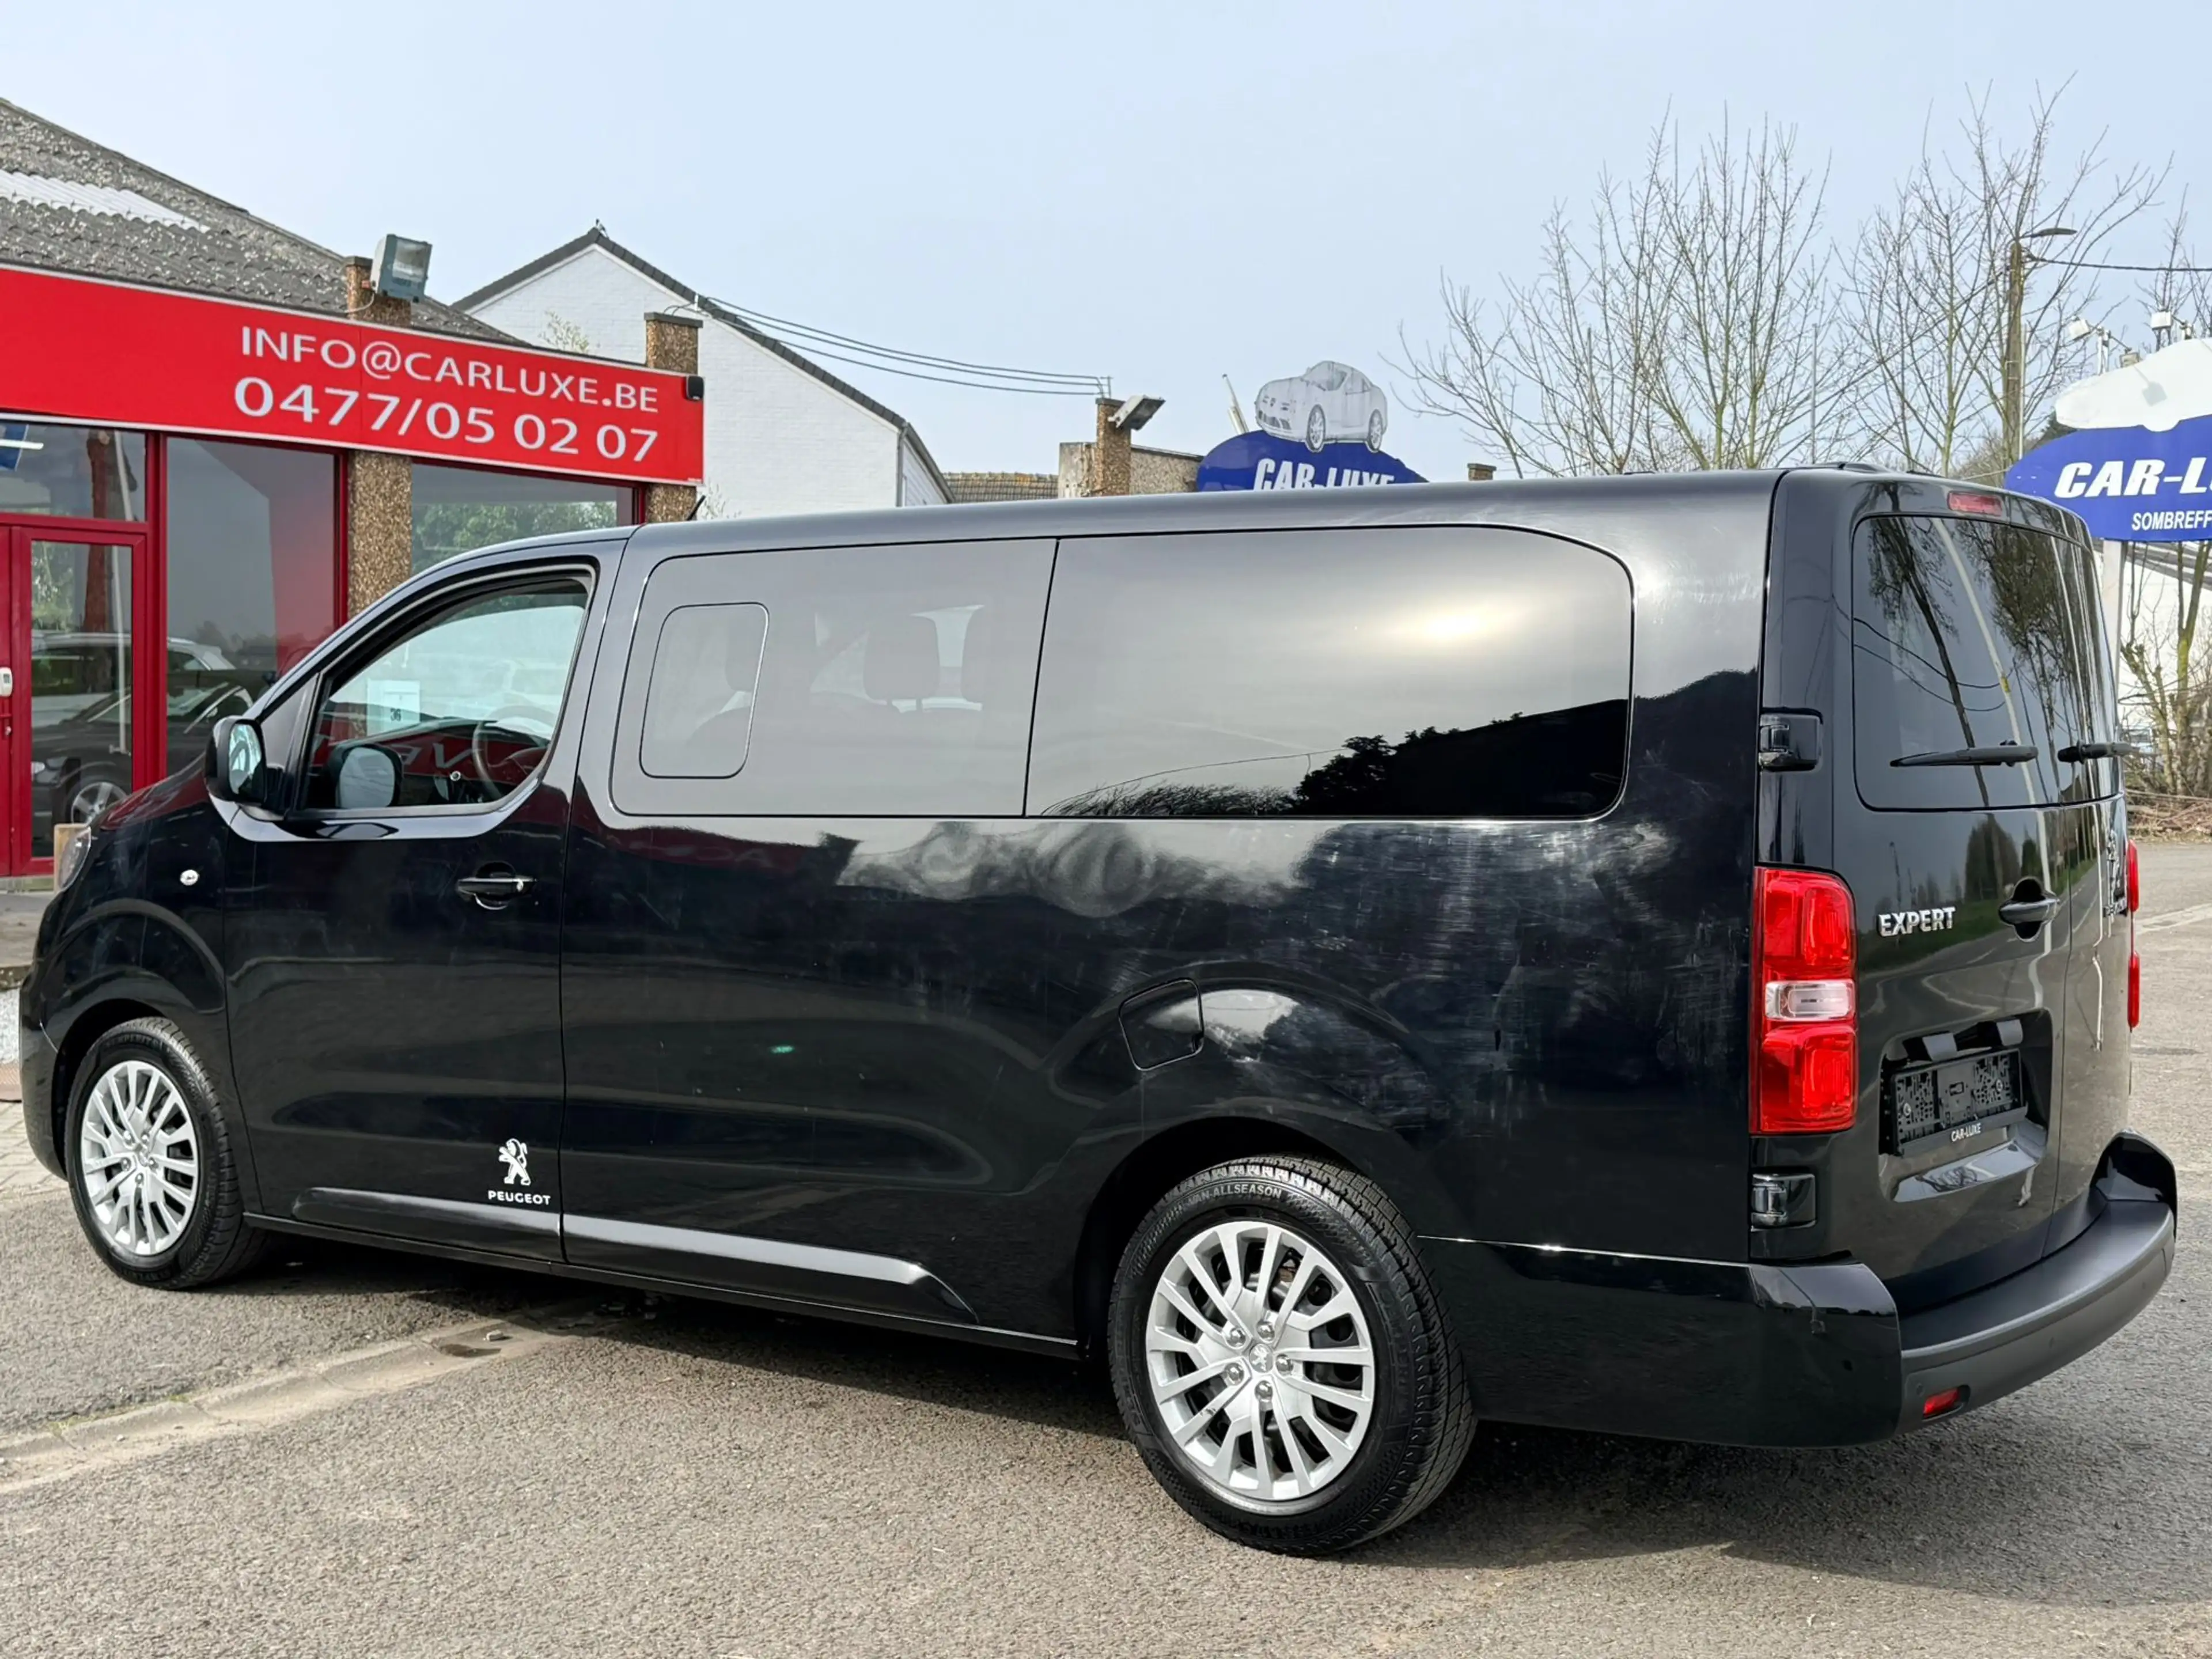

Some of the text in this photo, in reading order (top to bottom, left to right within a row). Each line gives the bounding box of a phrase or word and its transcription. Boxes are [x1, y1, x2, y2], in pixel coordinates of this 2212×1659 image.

[241, 327, 658, 413] INFO@CARLUXE.BE
[235, 377, 658, 461] 0477/05 02 07
[1253, 458, 1395, 490] CAR-LU
[2054, 457, 2212, 498] CAR-L
[1878, 906, 1956, 937] EXPERT
[488, 1190, 551, 1205] PEUGEOT
